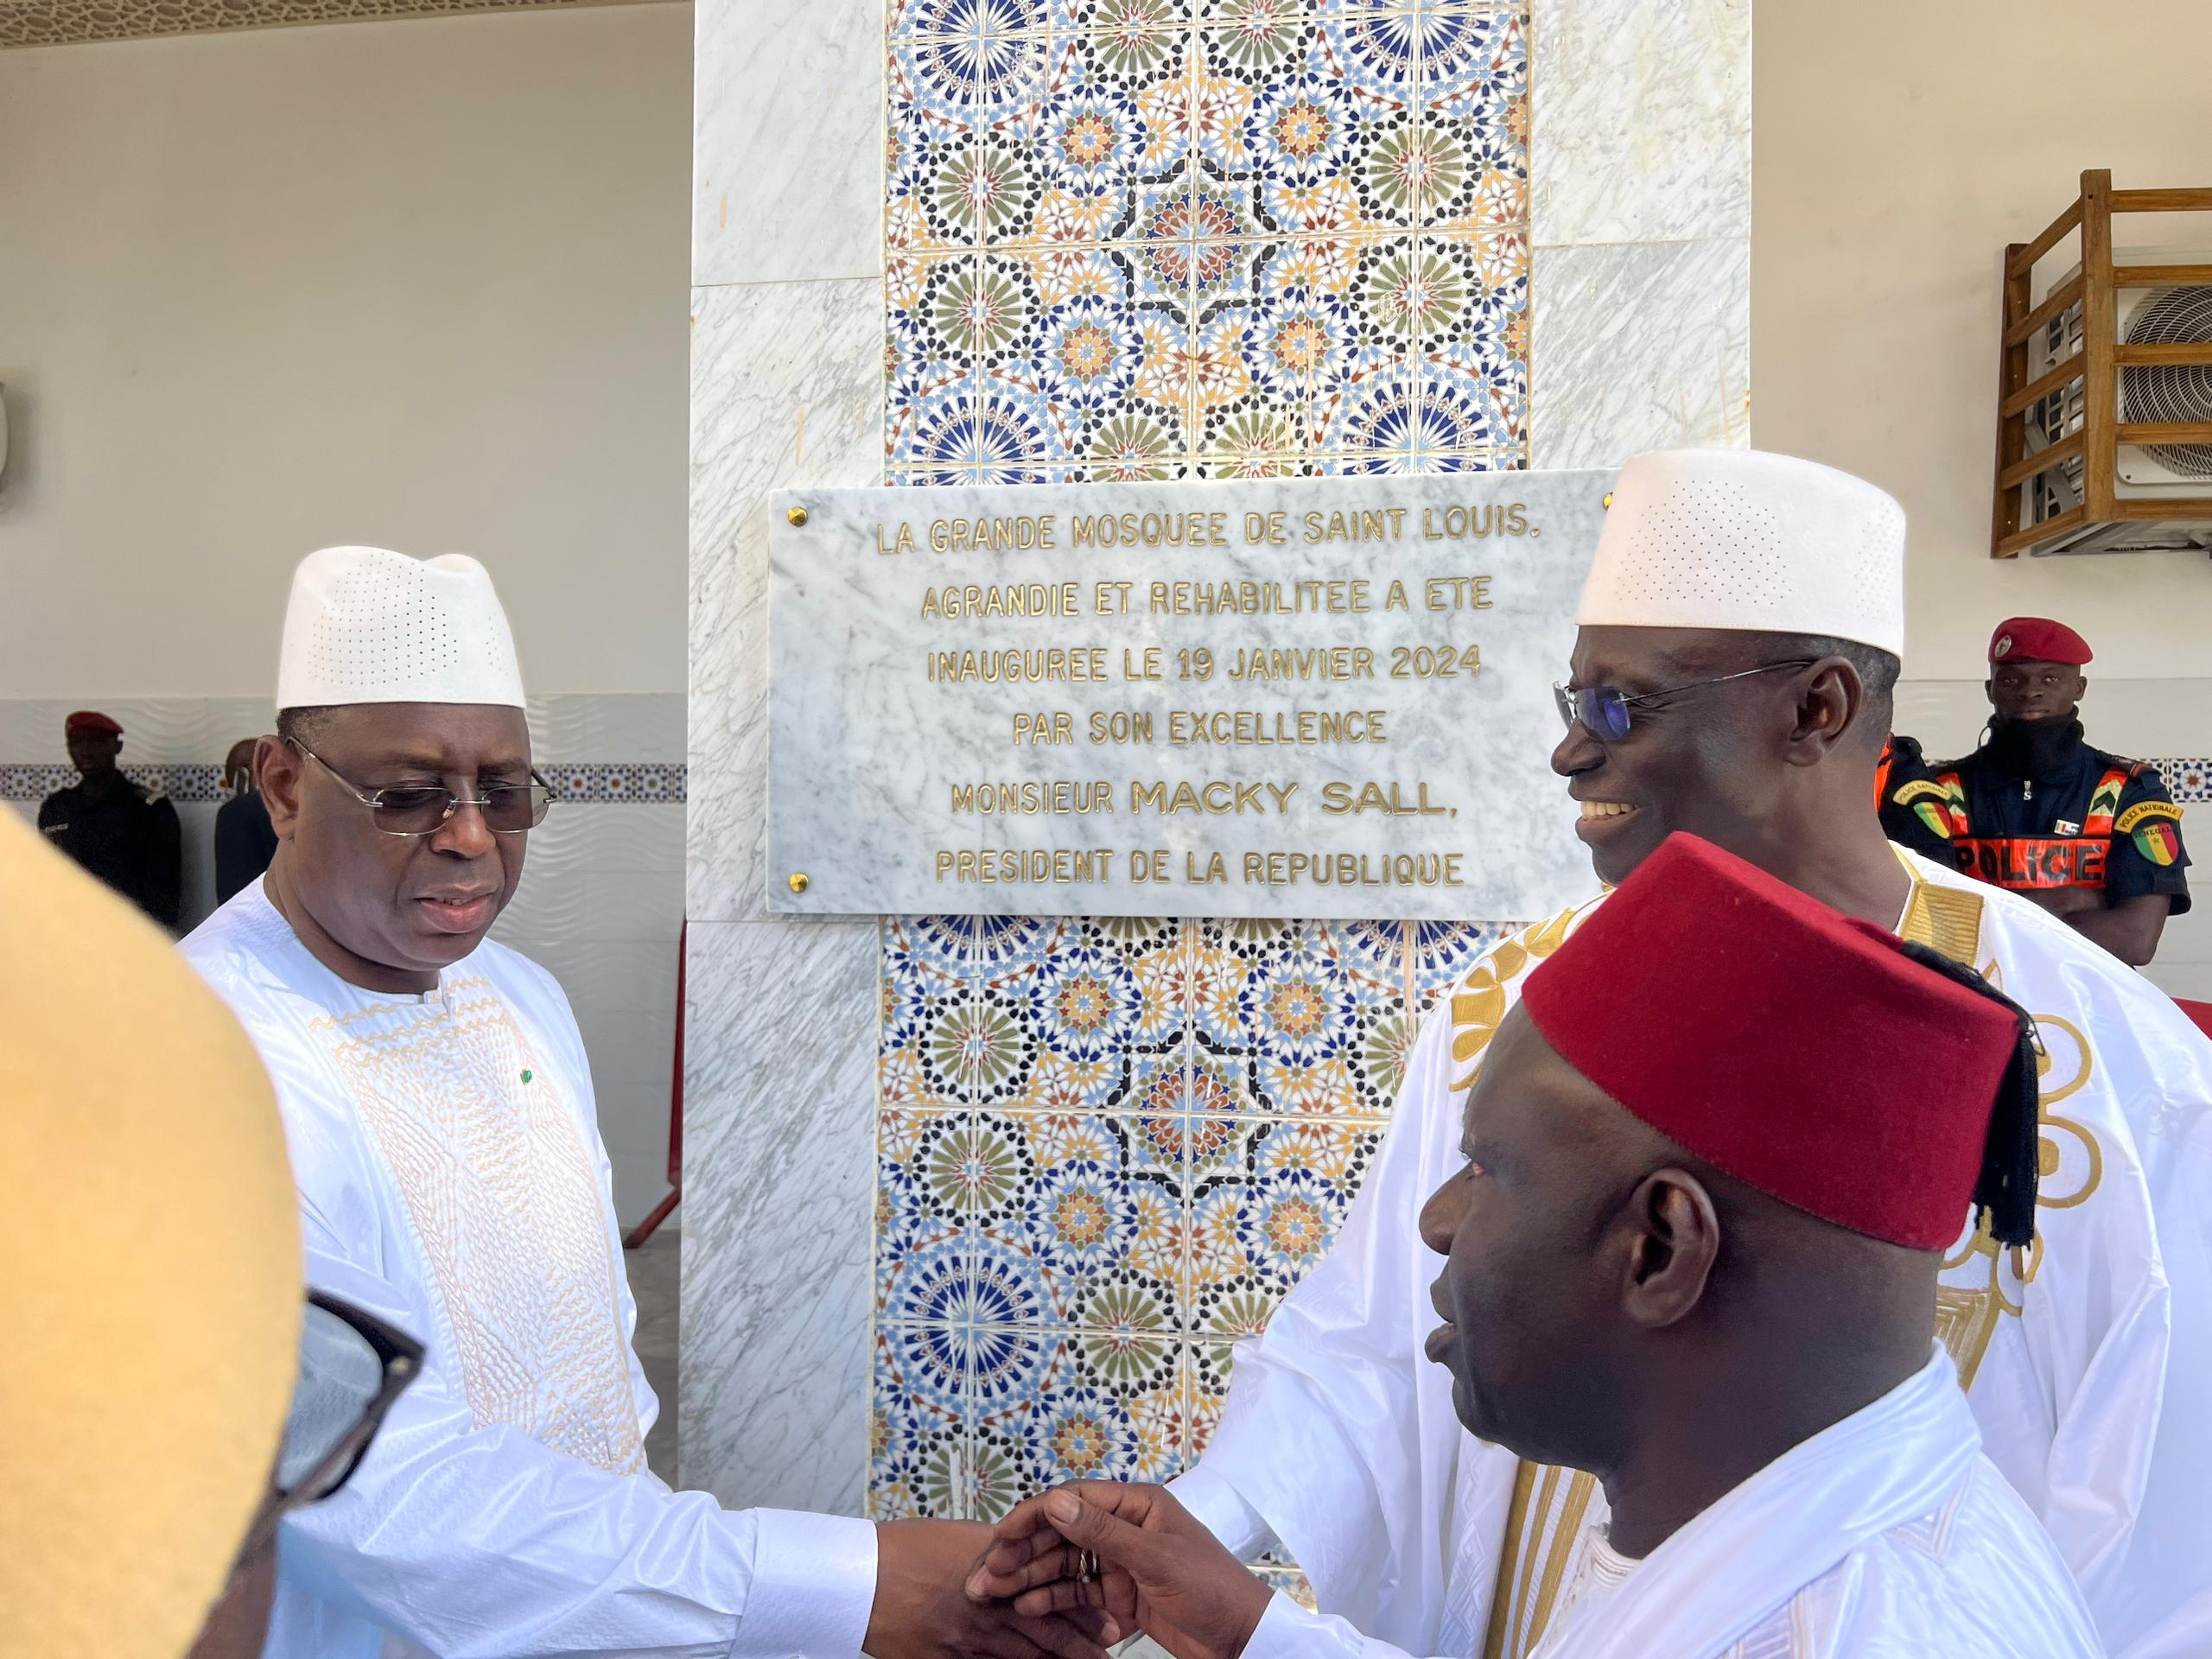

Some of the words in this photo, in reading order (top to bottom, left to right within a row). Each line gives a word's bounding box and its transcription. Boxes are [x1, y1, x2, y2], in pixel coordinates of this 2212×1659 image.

[878, 523, 915, 554] LA
[930, 516, 1056, 553] GRANDE
[1072, 512, 1227, 547] MOSQUEE
[1244, 512, 1287, 544] DE
[1303, 508, 1407, 543] SAINT
[1424, 503, 1541, 539] LOUIS.
[921, 583, 1079, 619] AGRANDIE
[1095, 582, 1133, 615] ET
[1149, 580, 1370, 614] REHABILITEE
[1386, 580, 1409, 610] A
[1426, 575, 1494, 610] ETE
[928, 648, 1108, 683] INAUGUREE
[1124, 647, 1162, 681] LE
[1179, 648, 1214, 681] 19
[1230, 647, 1375, 681] JANVIER
[1390, 645, 1481, 678] 2024
[1013, 712, 1073, 746] PAR
[1089, 711, 1154, 745] SON
[1170, 710, 1387, 745] EXCELLENCE
[951, 781, 1114, 816] MONSIEUR
[1131, 781, 1299, 816] MACKY
[1321, 782, 1458, 819] SALL,
[2119, 808, 2139, 829] POLICE
[2139, 803, 2178, 816] NATIONALE
[936, 849, 1114, 884] PRESIDENT
[1130, 849, 1172, 883] DE
[1187, 851, 1228, 883] LA
[1243, 852, 1465, 887] REPUBLIQUE
[1955, 844, 2103, 882] POLICE
